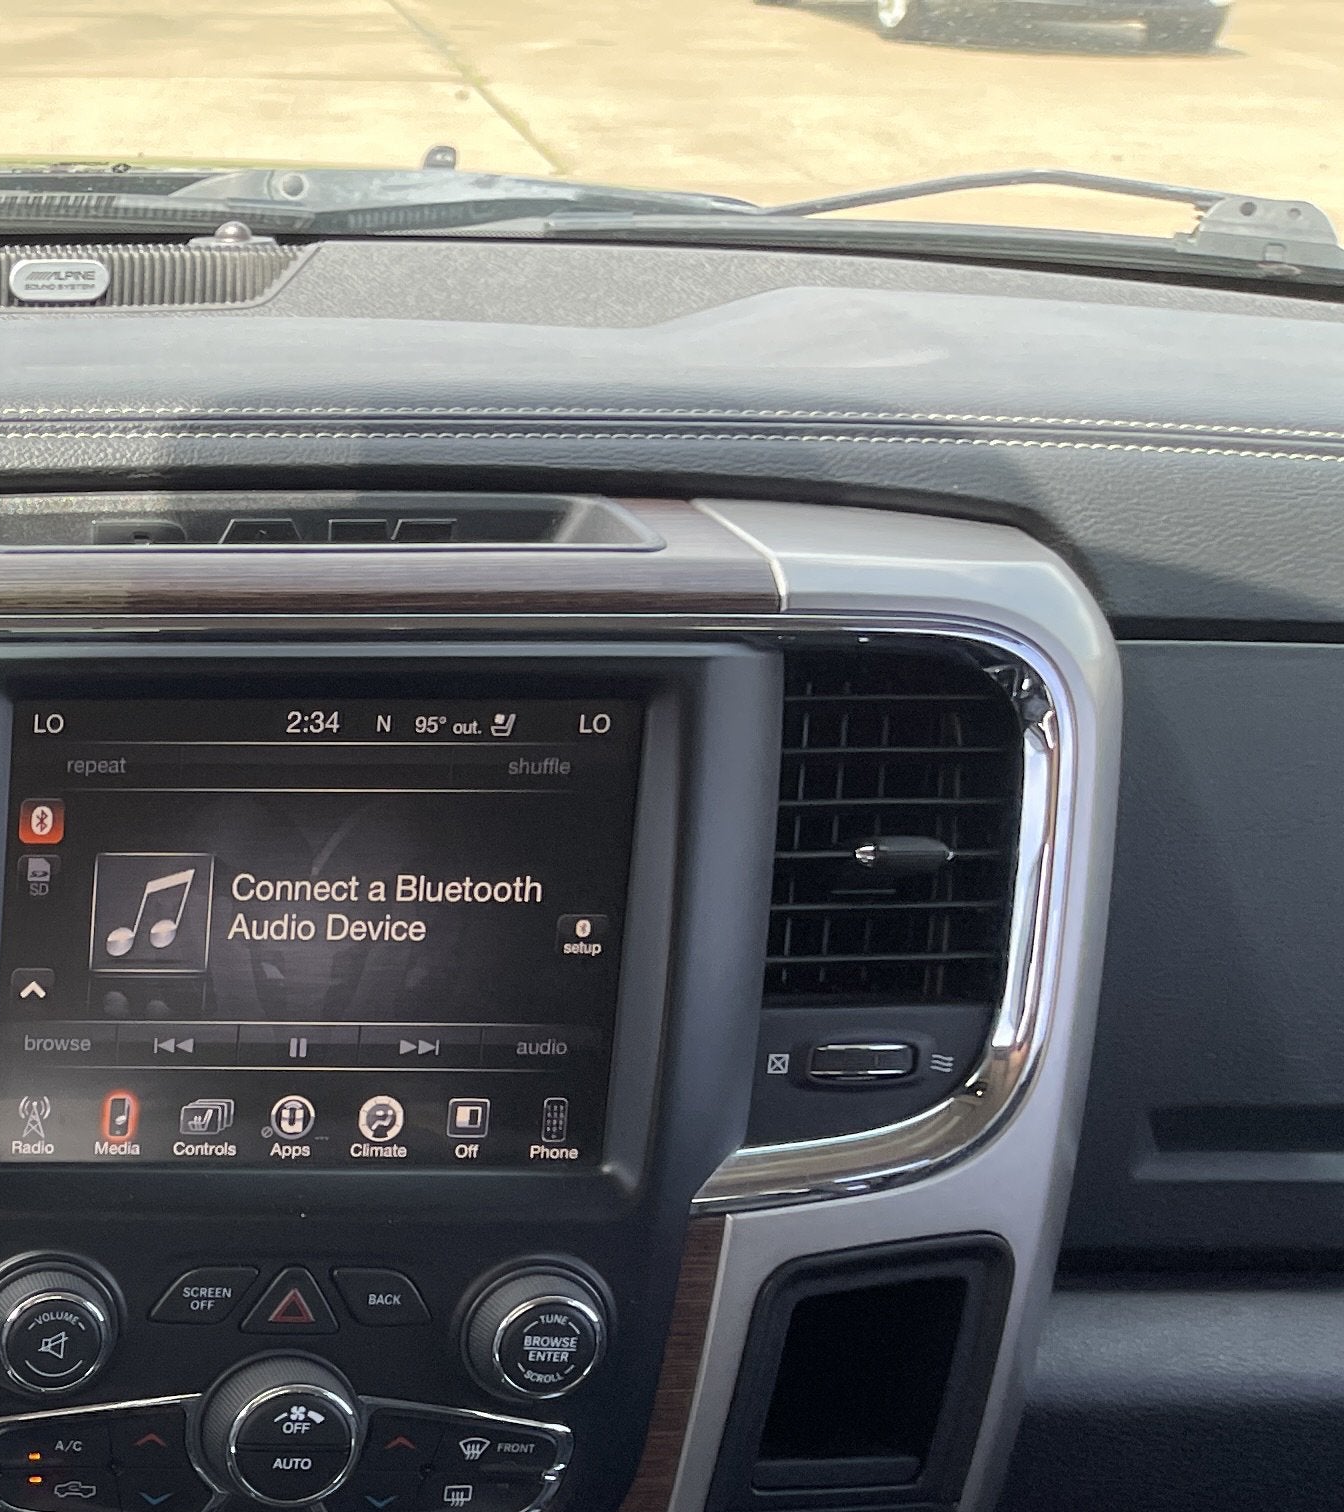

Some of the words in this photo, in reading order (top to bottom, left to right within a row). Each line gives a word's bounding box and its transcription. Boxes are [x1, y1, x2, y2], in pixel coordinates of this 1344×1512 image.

[33, 714, 64, 734] LO
[286, 711, 340, 734] 2:34
[376, 715, 392, 732] N
[415, 715, 447, 734] 95°
[452, 719, 481, 736] out.
[579, 714, 611, 734] LO
[66, 757, 126, 776] repeat
[507, 757, 571, 776] shuffle
[29, 882, 49, 896] SD
[231, 874, 359, 902] Connect
[368, 881, 386, 902] a
[396, 875, 543, 903] Bluetooth
[228, 915, 315, 941] Audio
[326, 916, 426, 942] Device
[563, 942, 602, 956] setup
[23, 1035, 91, 1052] browse
[516, 1038, 567, 1056] audio
[12, 1141, 55, 1156] Radio
[94, 1141, 140, 1156] Media
[173, 1142, 236, 1157] Controls
[270, 1143, 311, 1160] Apps
[350, 1143, 407, 1158] Climate
[455, 1144, 479, 1159] Off
[529, 1145, 578, 1160] Phone
[183, 1287, 232, 1299] SCREEN
[368, 1293, 401, 1305] BACK
[190, 1300, 215, 1311] OFF
[34, 1312, 79, 1326] VOLUME
[540, 1314, 569, 1325] TUNE
[524, 1335, 577, 1348] BROWSE
[528, 1351, 569, 1363] ENTER
[524, 1369, 563, 1384] SCROLL
[282, 1422, 310, 1435] OFF
[54, 1440, 82, 1452] A/C
[497, 1442, 535, 1454] FRONT
[273, 1458, 312, 1471] AUTO
